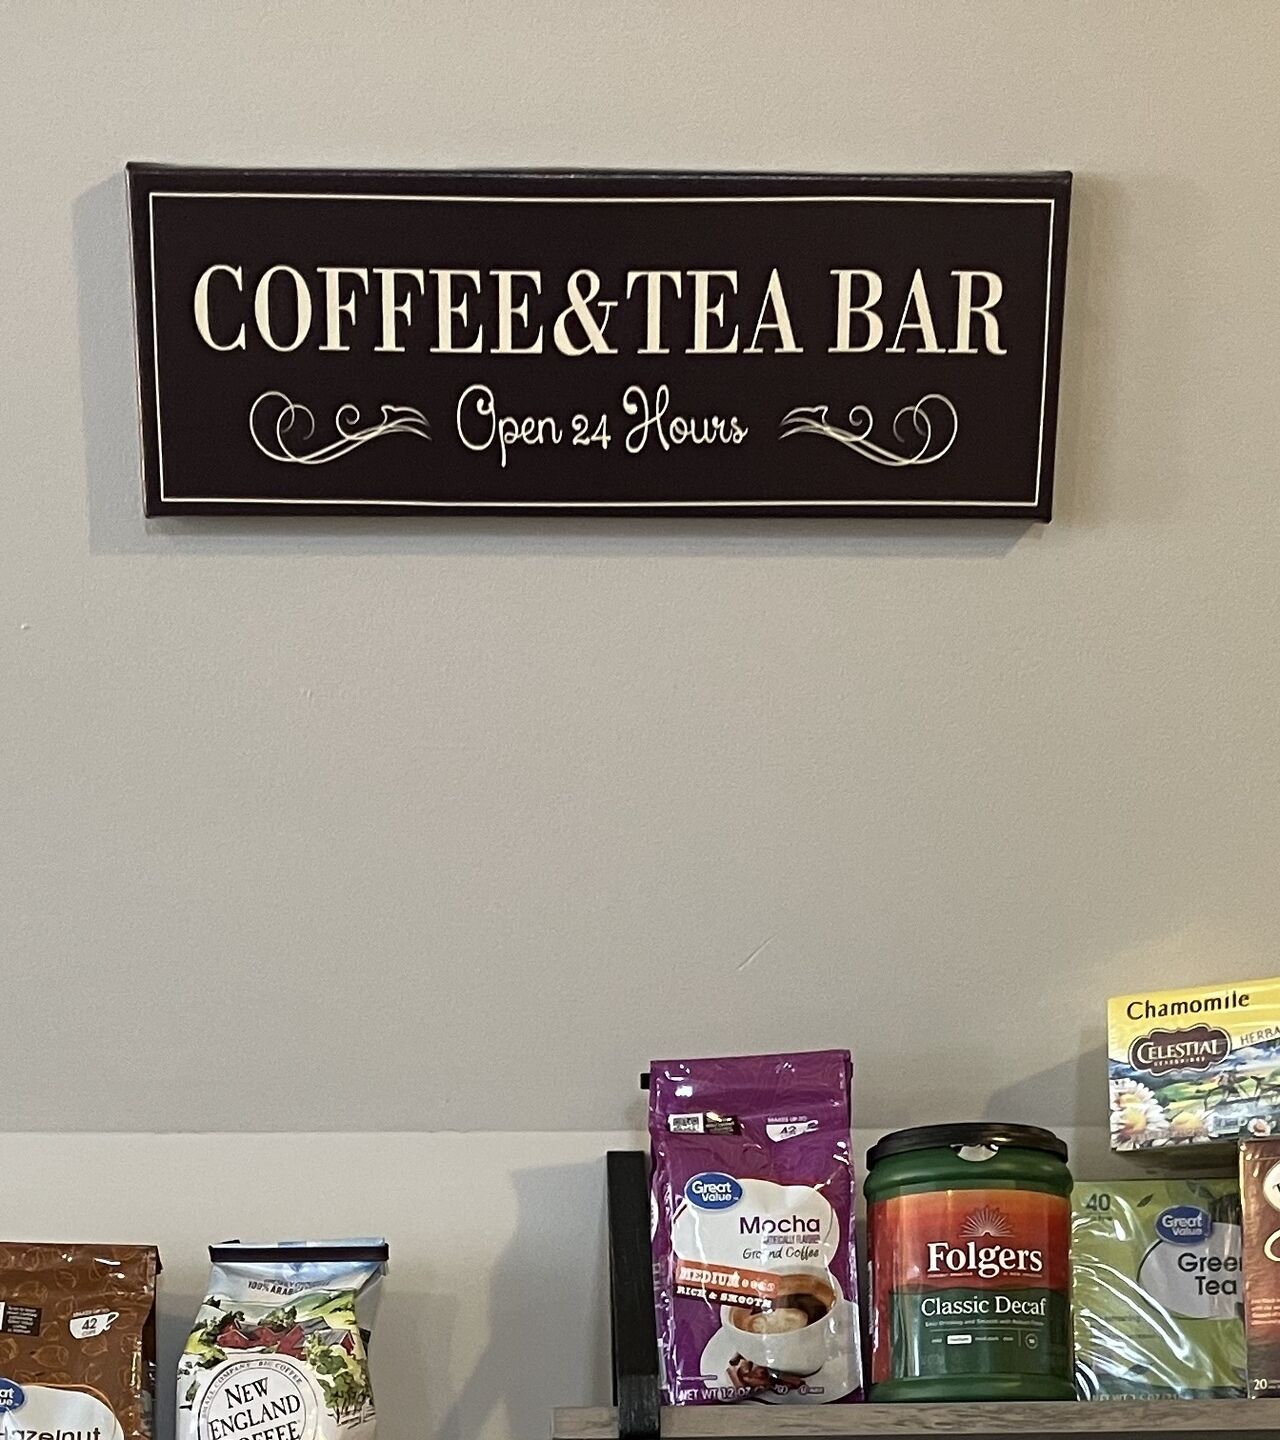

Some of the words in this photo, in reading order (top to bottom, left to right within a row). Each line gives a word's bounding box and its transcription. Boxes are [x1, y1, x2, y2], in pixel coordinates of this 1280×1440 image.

[194, 264, 803, 357] COFFEE&TEA
[828, 268, 1007, 357] BAR
[456, 383, 562, 467] Open
[572, 418, 612, 450] 24
[623, 384, 749, 455] Hours
[1126, 990, 1251, 1021] Chamomile
[1136, 1039, 1218, 1065] CELESTIAL
[691, 1180, 733, 1195] Great
[700, 1189, 733, 1203] Value
[1085, 1193, 1111, 1212] 40
[739, 1214, 821, 1235] Mocha
[1160, 1213, 1204, 1229] Great
[1170, 1225, 1203, 1237] Value
[785, 1246, 820, 1261] Coffee
[926, 1241, 1043, 1279] Folgers
[678, 1265, 740, 1288] MEDIUM
[1194, 1275, 1238, 1297] Tea
[676, 1285, 706, 1299] RICH
[708, 1291, 718, 1300] &
[719, 1292, 773, 1309] SMOOTH
[921, 1295, 990, 1317] Classic
[994, 1295, 1047, 1317] Decaf
[81, 1317, 99, 1331] 42
[214, 1362, 251, 1389] COMPANY
[274, 1362, 303, 1385] COFFEE
[1252, 1378, 1268, 1391] 20
[224, 1376, 269, 1410] NEW
[702, 1388, 718, 1400] WT
[721, 1387, 734, 1400] 12
